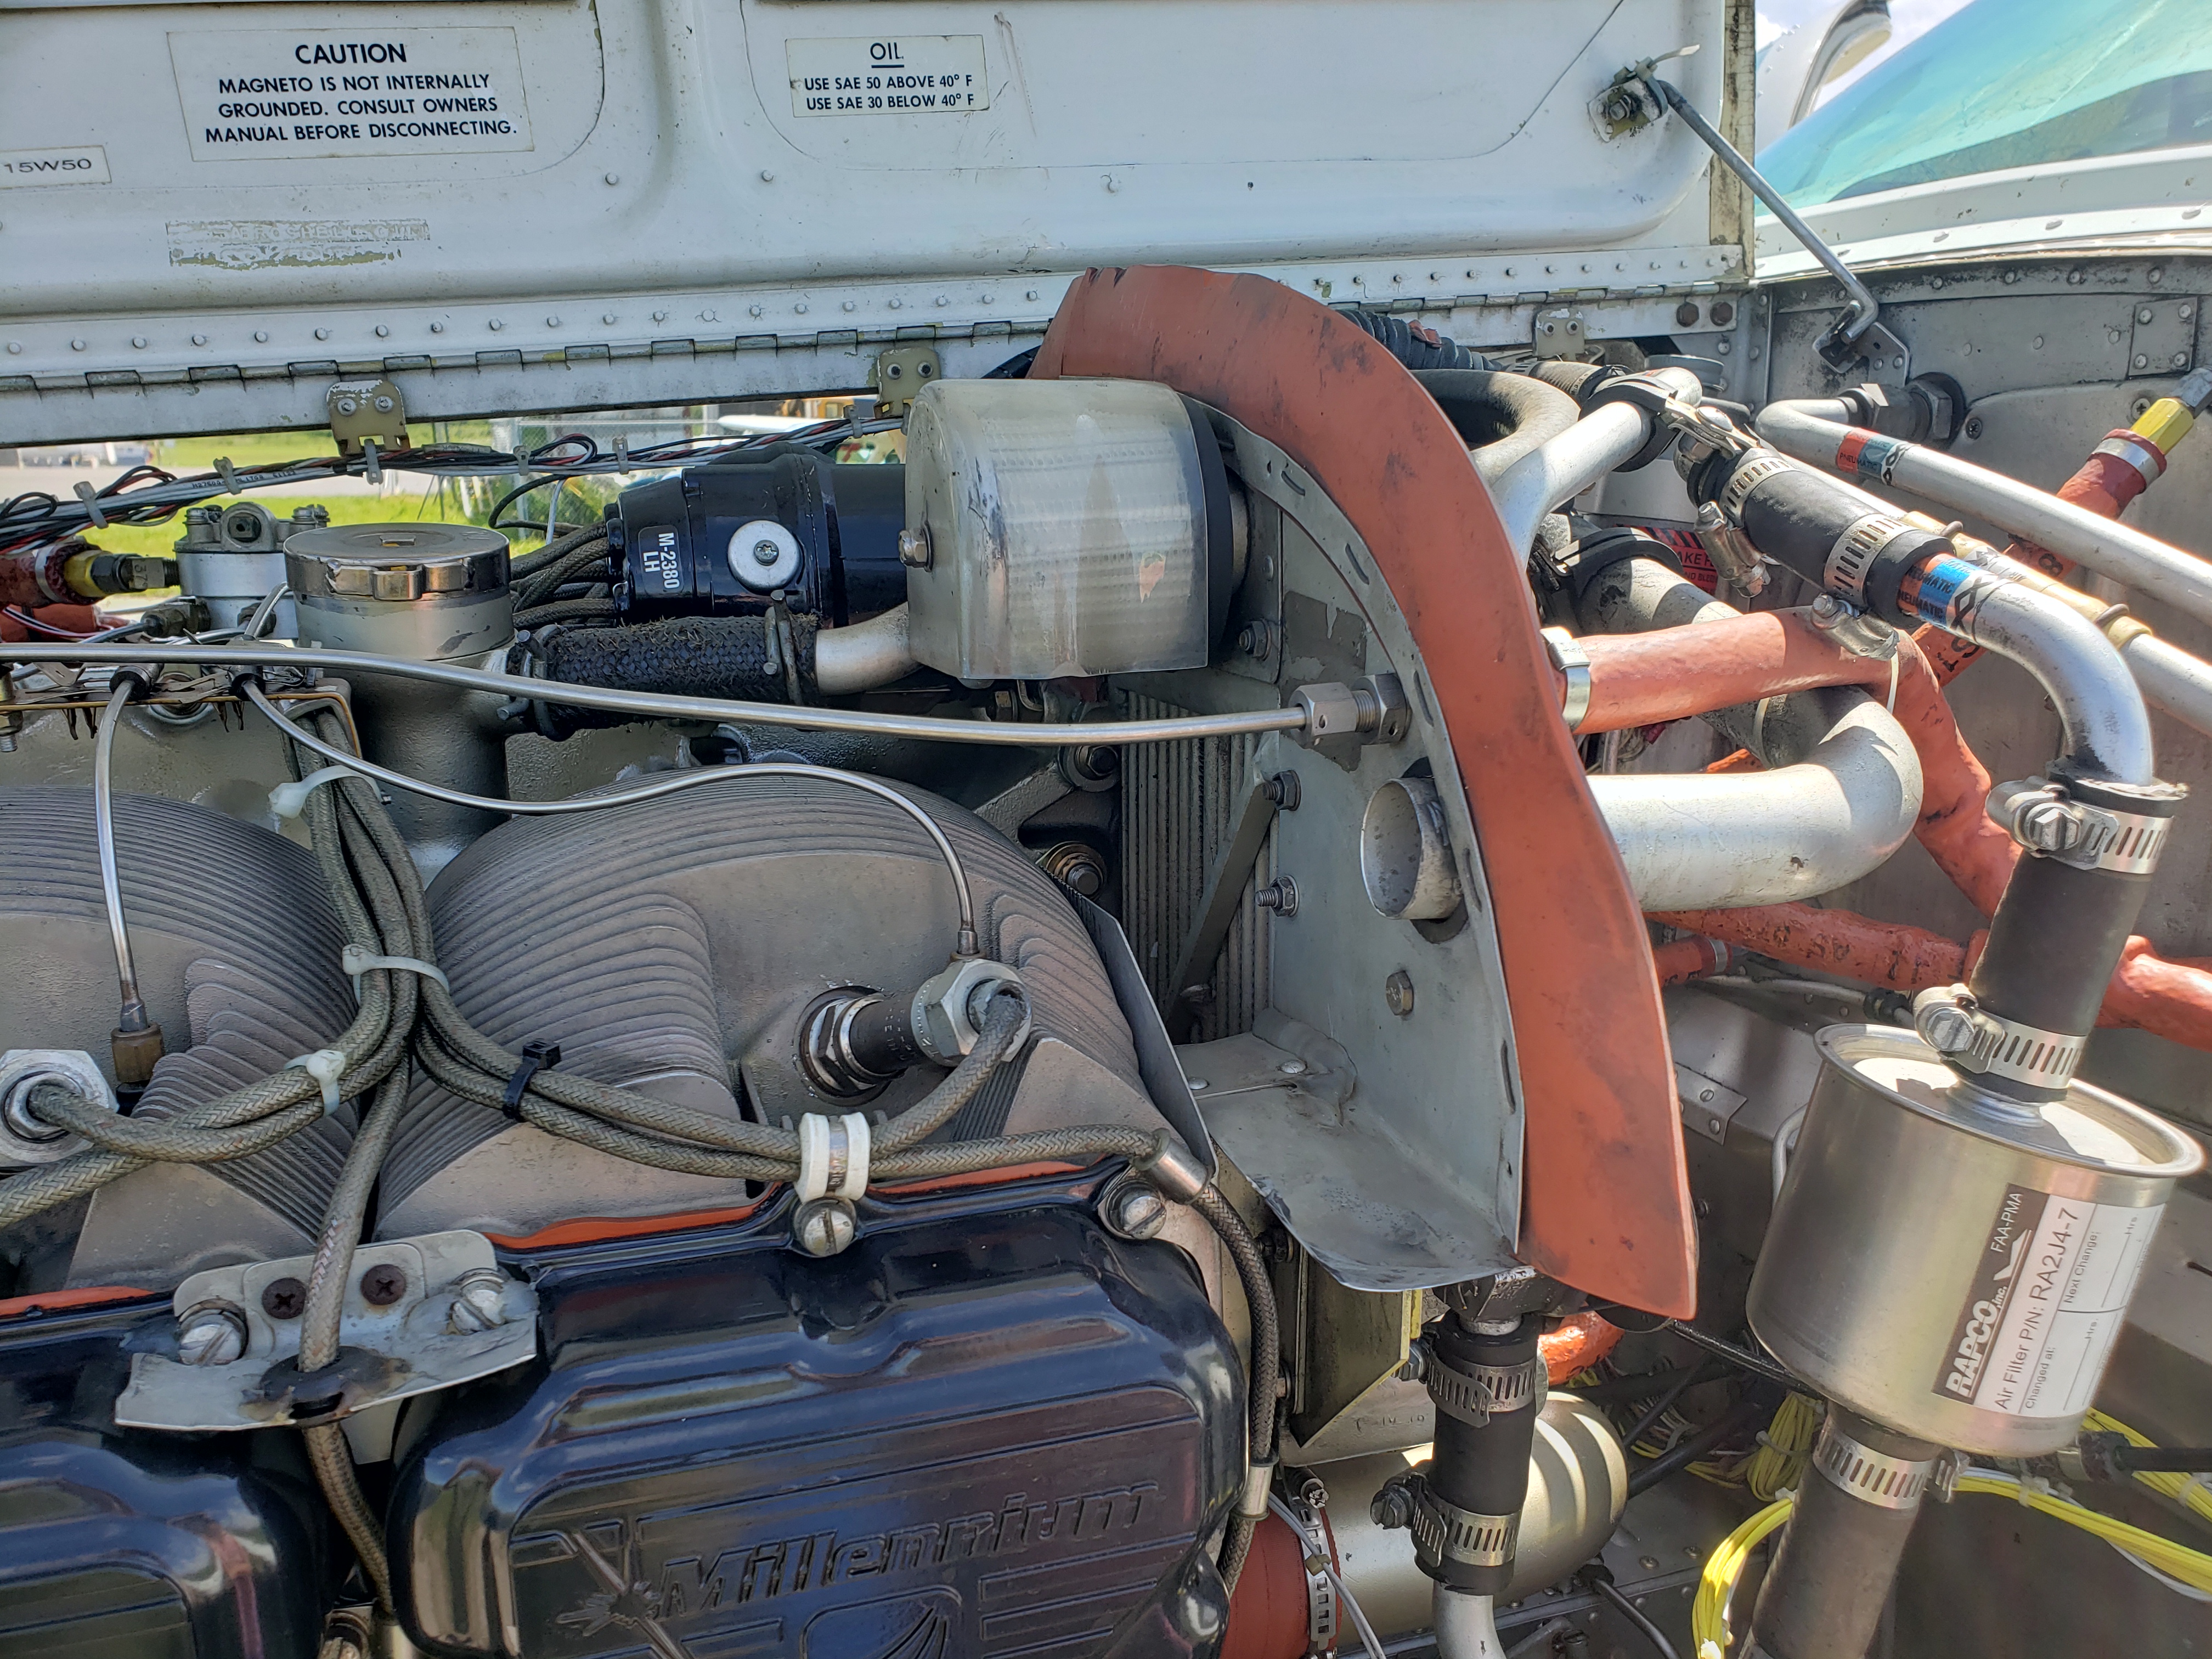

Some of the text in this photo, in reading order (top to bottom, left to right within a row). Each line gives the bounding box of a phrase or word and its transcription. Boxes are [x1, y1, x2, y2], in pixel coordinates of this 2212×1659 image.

[295, 43, 407, 64] CAUTION
[870, 42, 904, 60] OIL
[219, 74, 489, 94] MAGNETO IS NOT INTERNALLY
[804, 78, 830, 91] USE
[835, 77, 861, 89] SAE
[866, 76, 881, 89] 50
[886, 75, 935, 88] ABOVE
[966, 75, 973, 87] F
[218, 97, 498, 118] GROUNDED. CONSULT OWNERS
[806, 97, 832, 110] USE
[837, 97, 863, 109] SAE
[867, 97, 883, 108] 30
[888, 95, 936, 108] BELOW
[967, 94, 974, 105] F
[206, 120, 517, 143] MANUAL BEFORE DISCONNECTING.
[4, 159, 92, 173] 15W50
[1839, 453, 1878, 471] PNEUMATIC
[643, 551, 661, 572] LH
[658, 533, 680, 589] M-2380
[1990, 1193, 2023, 1252] FAA-PMA
[2063, 1279, 2081, 1304] Next
[1994, 1207, 2079, 1410] Air Filter P/N: RA2J4-7
[2084, 1318, 2099, 1340] Hrs.
[1945, 1300, 1999, 1398] RAPCO
[2025, 1363, 2050, 1409] Changed
[660, 1482, 1159, 1615] Millennium
